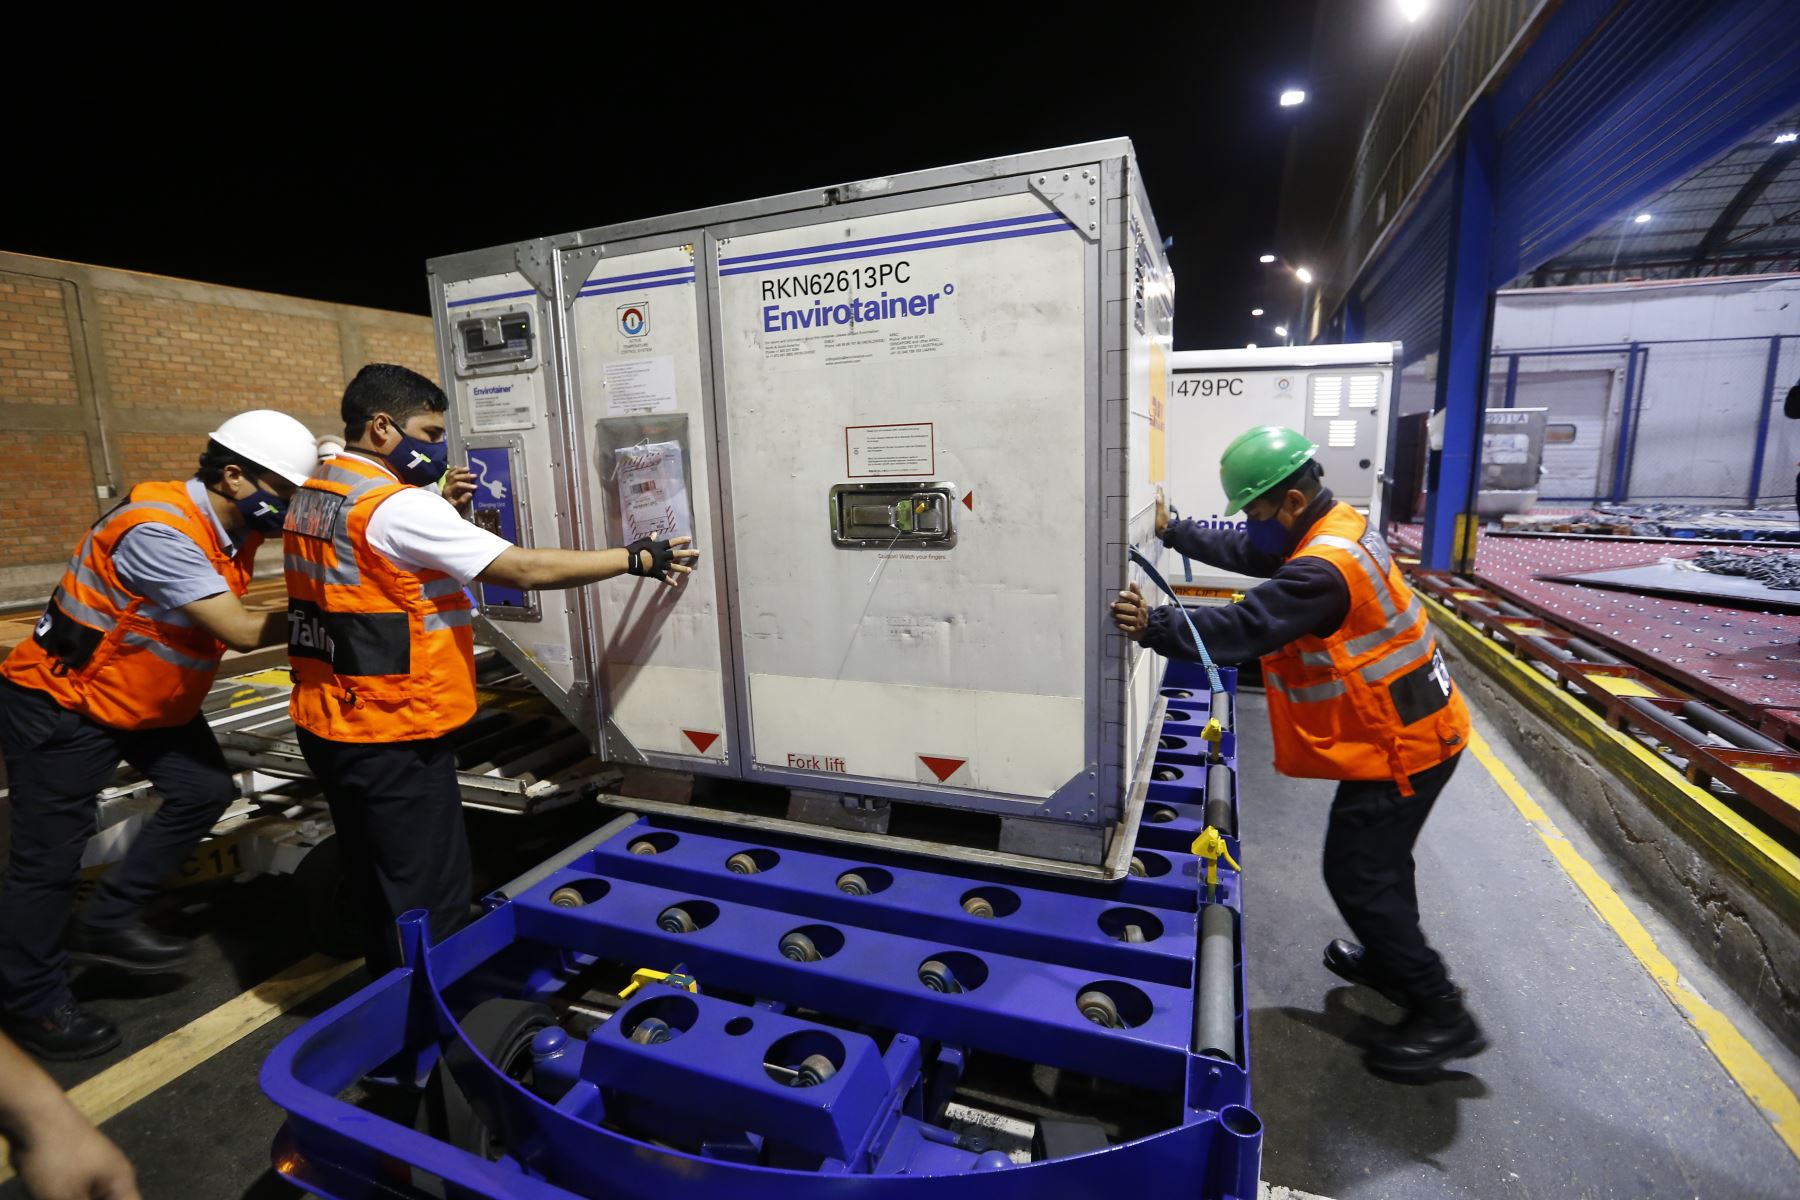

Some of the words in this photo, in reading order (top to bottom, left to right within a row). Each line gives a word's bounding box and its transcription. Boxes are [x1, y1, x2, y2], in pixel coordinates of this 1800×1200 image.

[762, 261, 911, 301] RKN62613PC
[763, 291, 940, 332] Envirotainer
[473, 385, 511, 396] Envirotainer
[787, 753, 821, 769] Fork
[825, 757, 846, 773] lift
